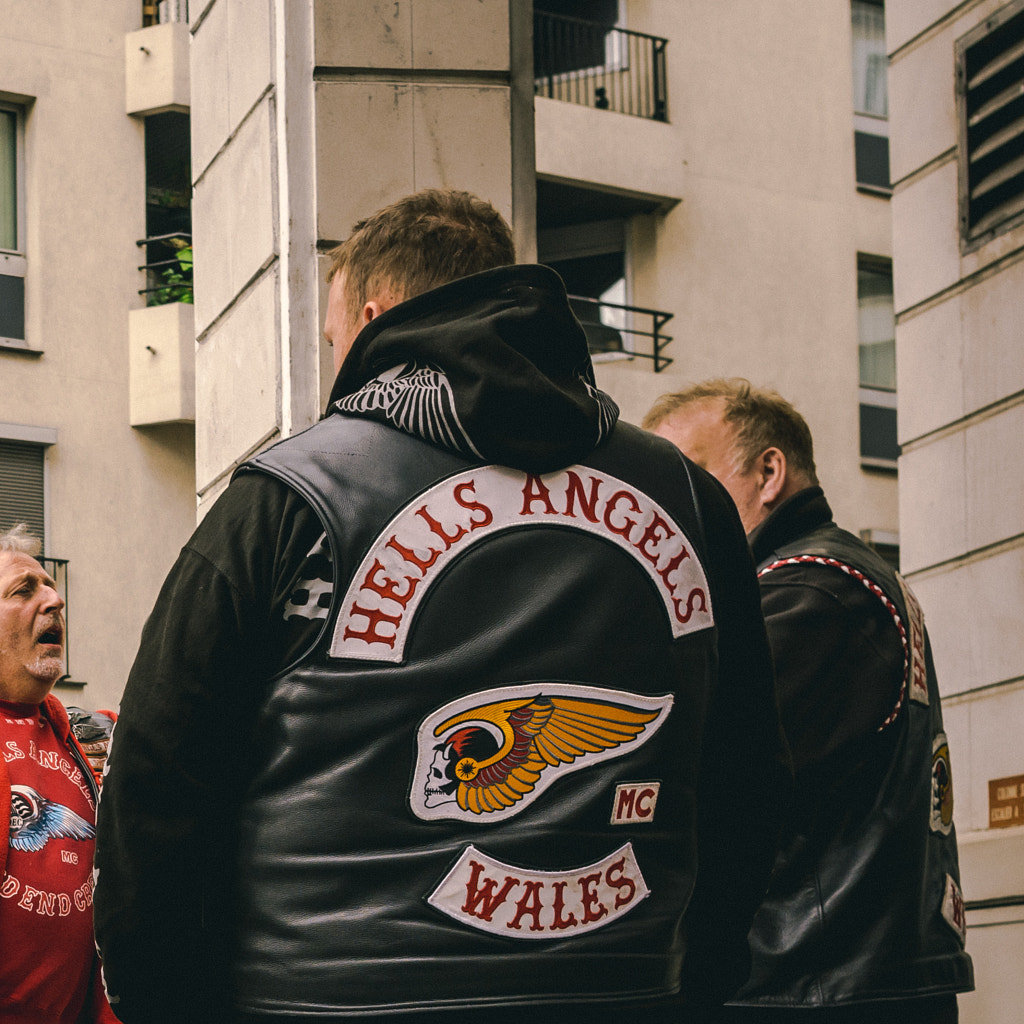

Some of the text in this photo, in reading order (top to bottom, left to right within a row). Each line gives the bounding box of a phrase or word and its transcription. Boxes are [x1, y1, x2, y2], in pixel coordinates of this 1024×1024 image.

[342, 479, 494, 650] HELLS
[519, 470, 708, 624] ANGELS
[614, 789, 654, 820] MC
[61, 849, 79, 865] MC
[462, 857, 636, 931] WALES
